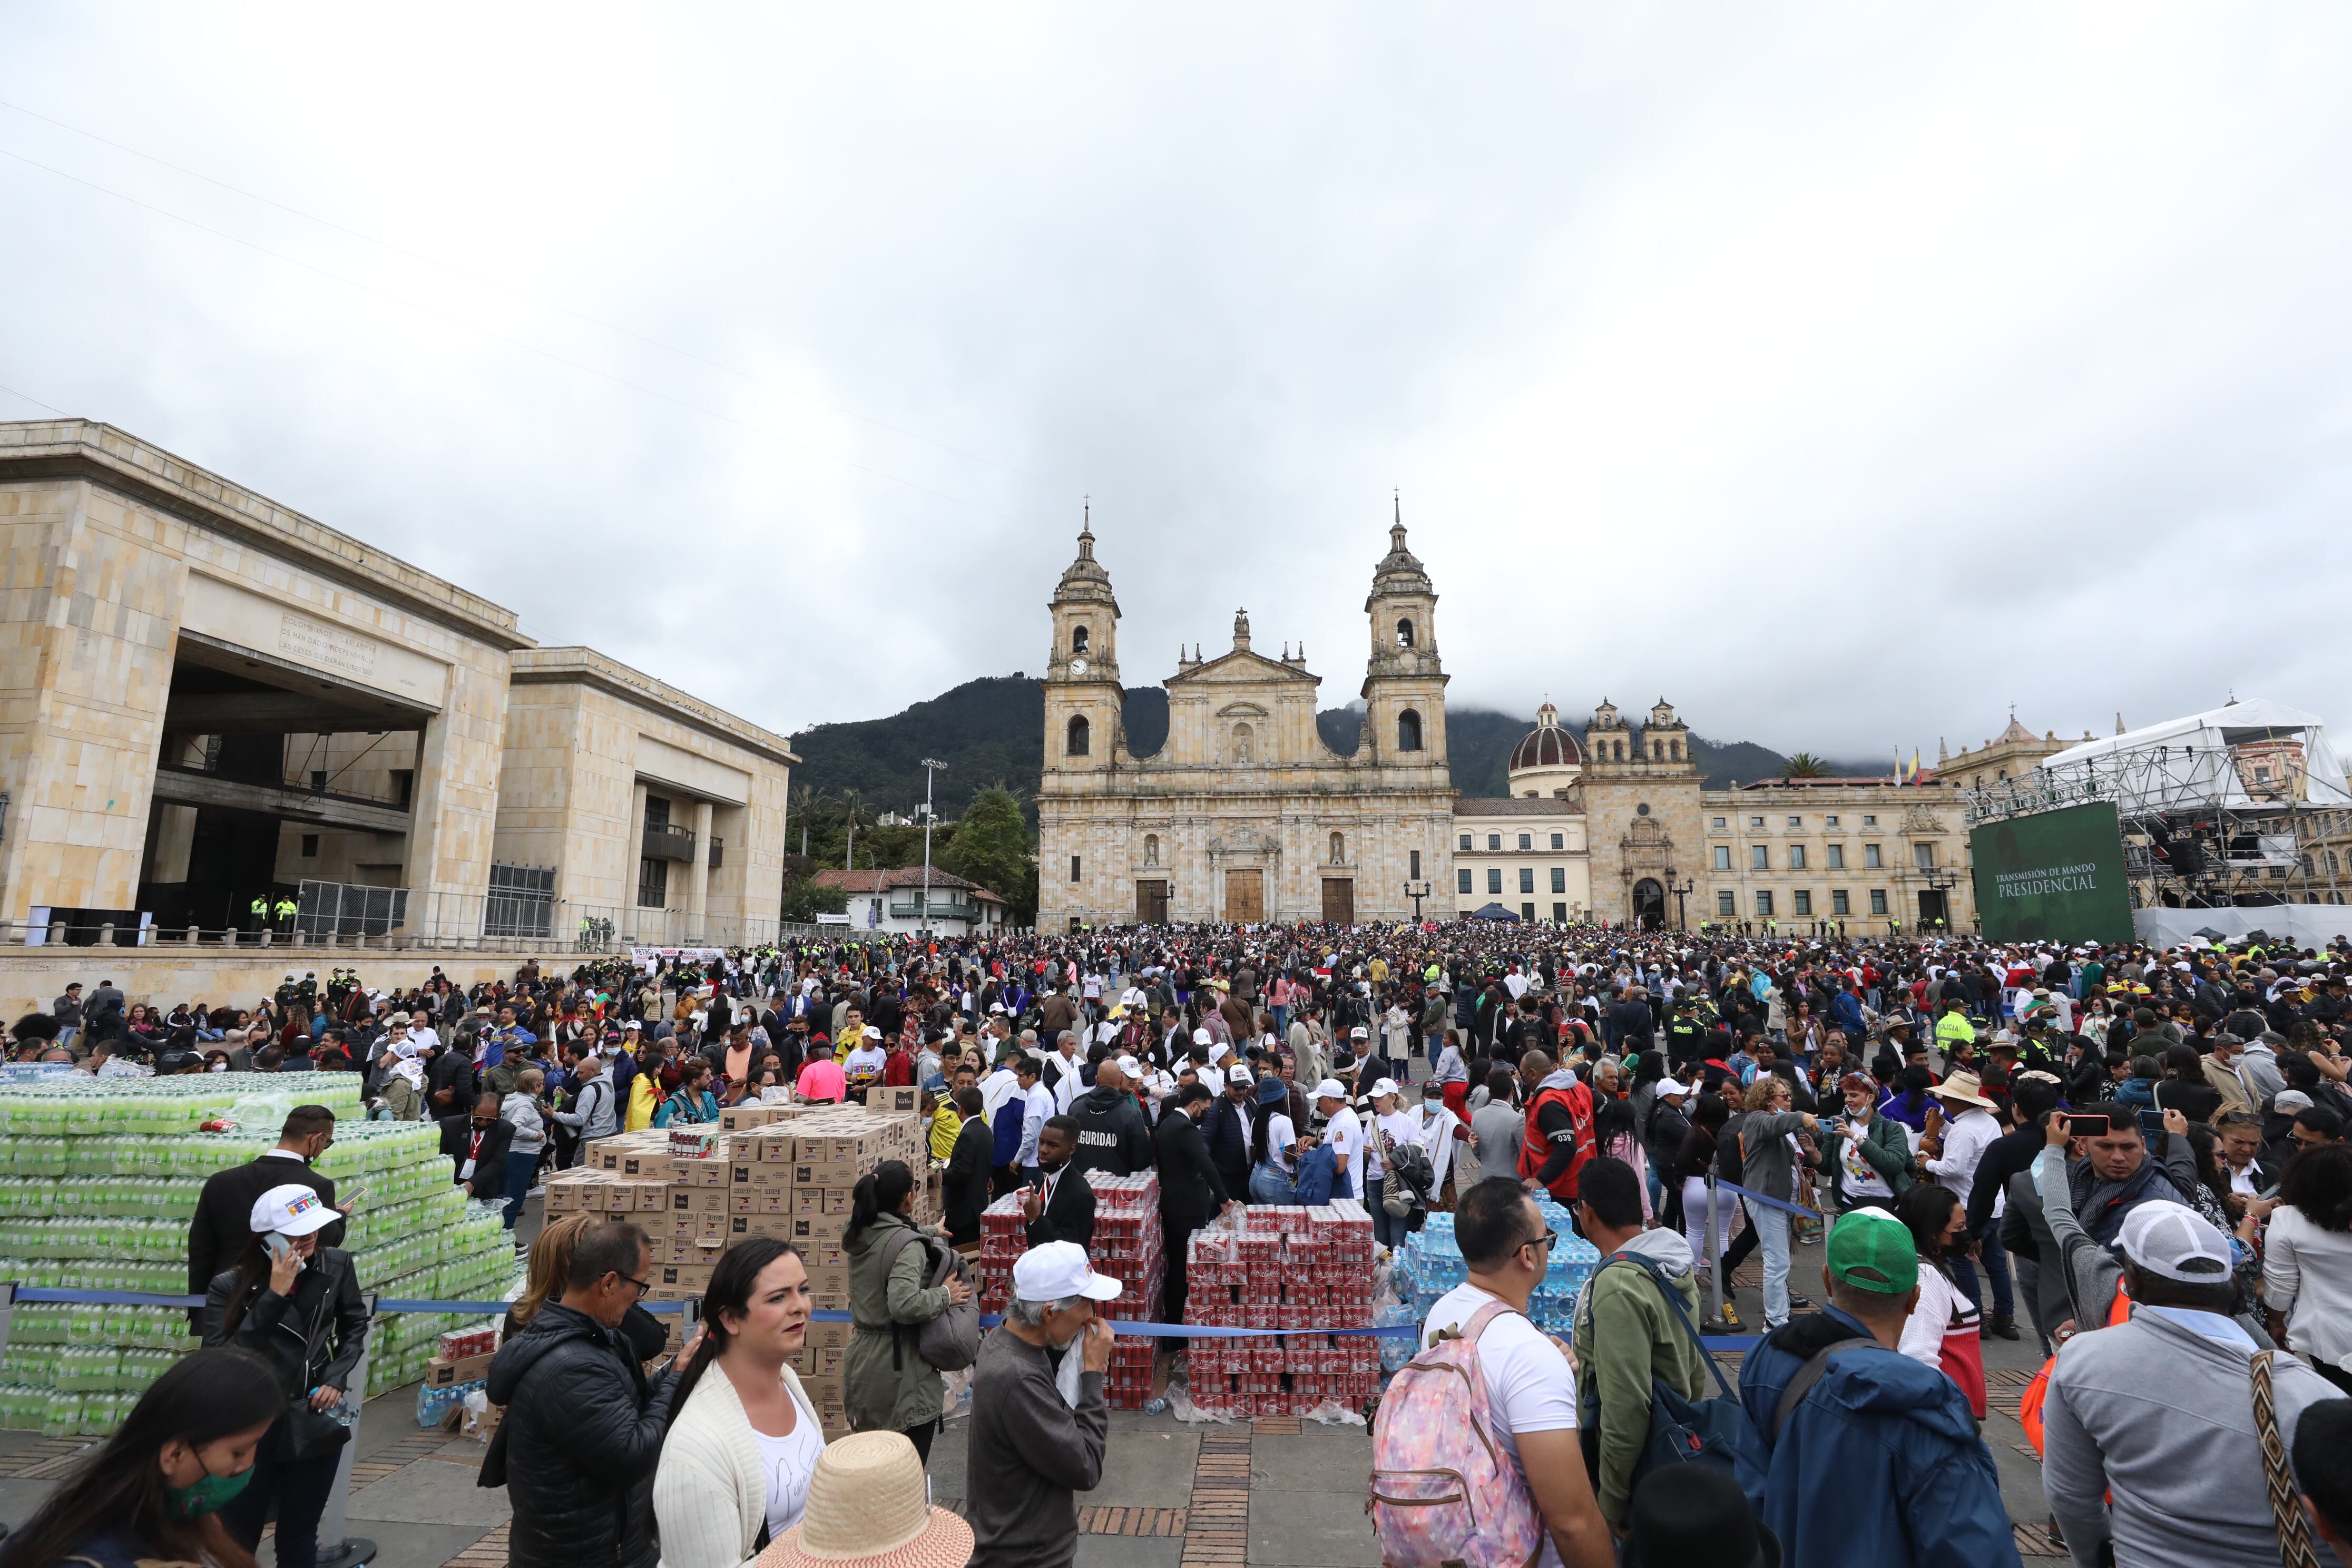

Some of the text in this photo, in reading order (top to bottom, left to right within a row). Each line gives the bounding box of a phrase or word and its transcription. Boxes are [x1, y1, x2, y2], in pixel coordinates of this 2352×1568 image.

[283, 616, 332, 638] COLOMBIANOS
[356, 641, 376, 653] ARMAS
[293, 632, 306, 641] HAN
[308, 636, 327, 648] DADO
[329, 644, 374, 664] INDEPENDENCIA
[293, 646, 312, 656] LEYES
[346, 663, 373, 676] LIBERTAD
[1995, 863, 2095, 883] TRANSMISIÓN DE MANDO
[1999, 875, 2096, 897] PRESIDENCIAL
[1078, 1130, 1117, 1147] GURIDAD
